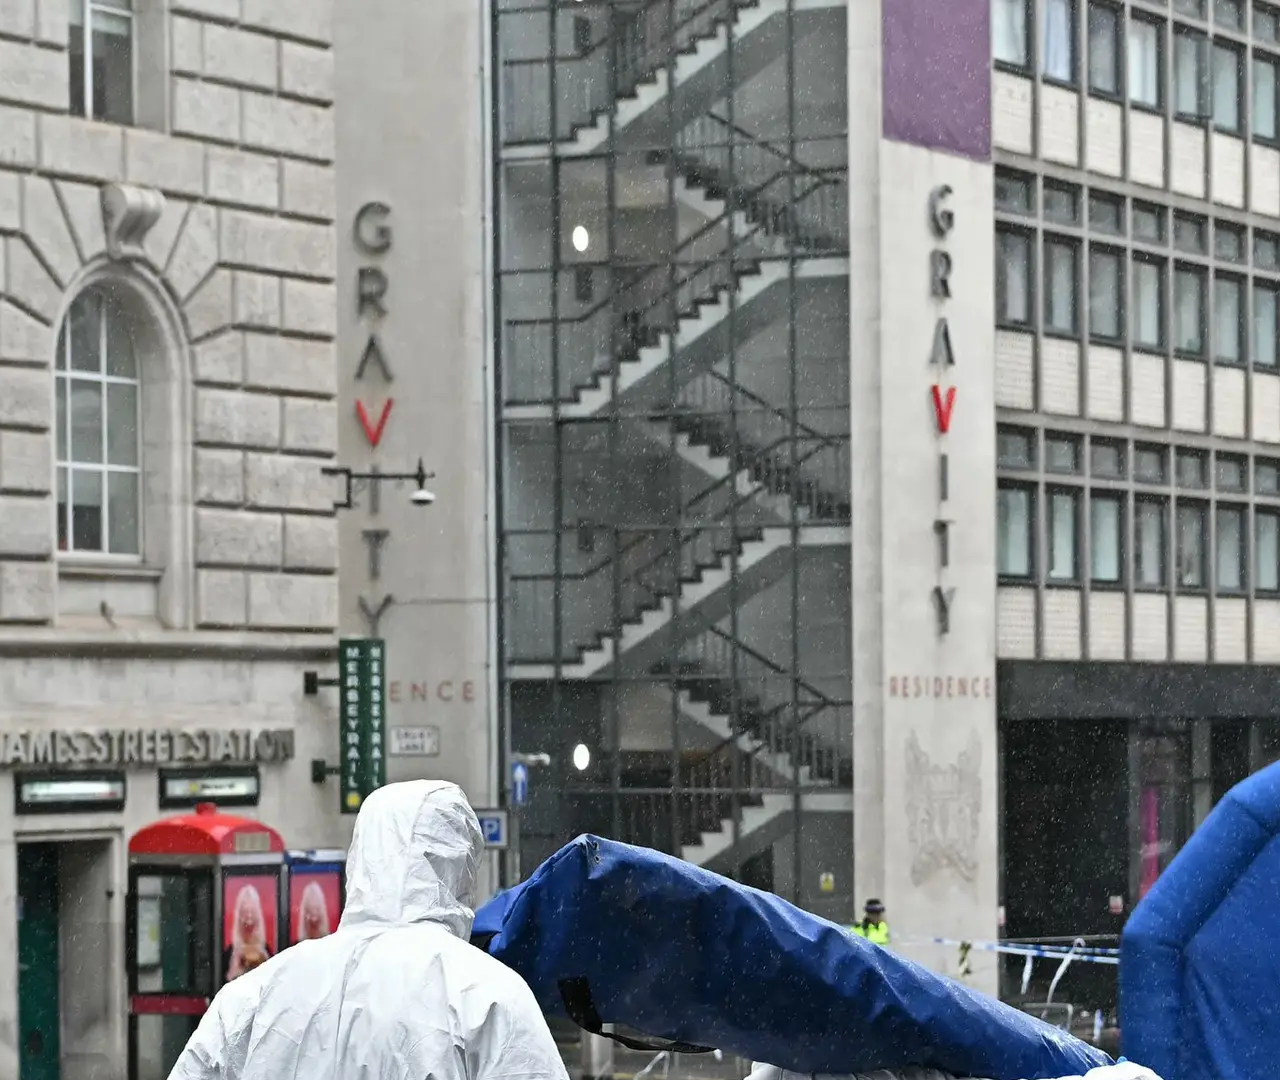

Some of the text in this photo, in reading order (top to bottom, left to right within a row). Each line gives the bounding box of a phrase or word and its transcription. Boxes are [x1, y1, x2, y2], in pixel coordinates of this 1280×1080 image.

[353, 202, 393, 638] GRAVITY
[926, 184, 957, 635] GRAVITY
[345, 647, 360, 788] MERSEYRAIL
[388, 680, 476, 703] ENCE
[888, 675, 992, 698] RESIDENCE
[95, 729, 179, 763] STREET
[187, 728, 295, 762] STATION
